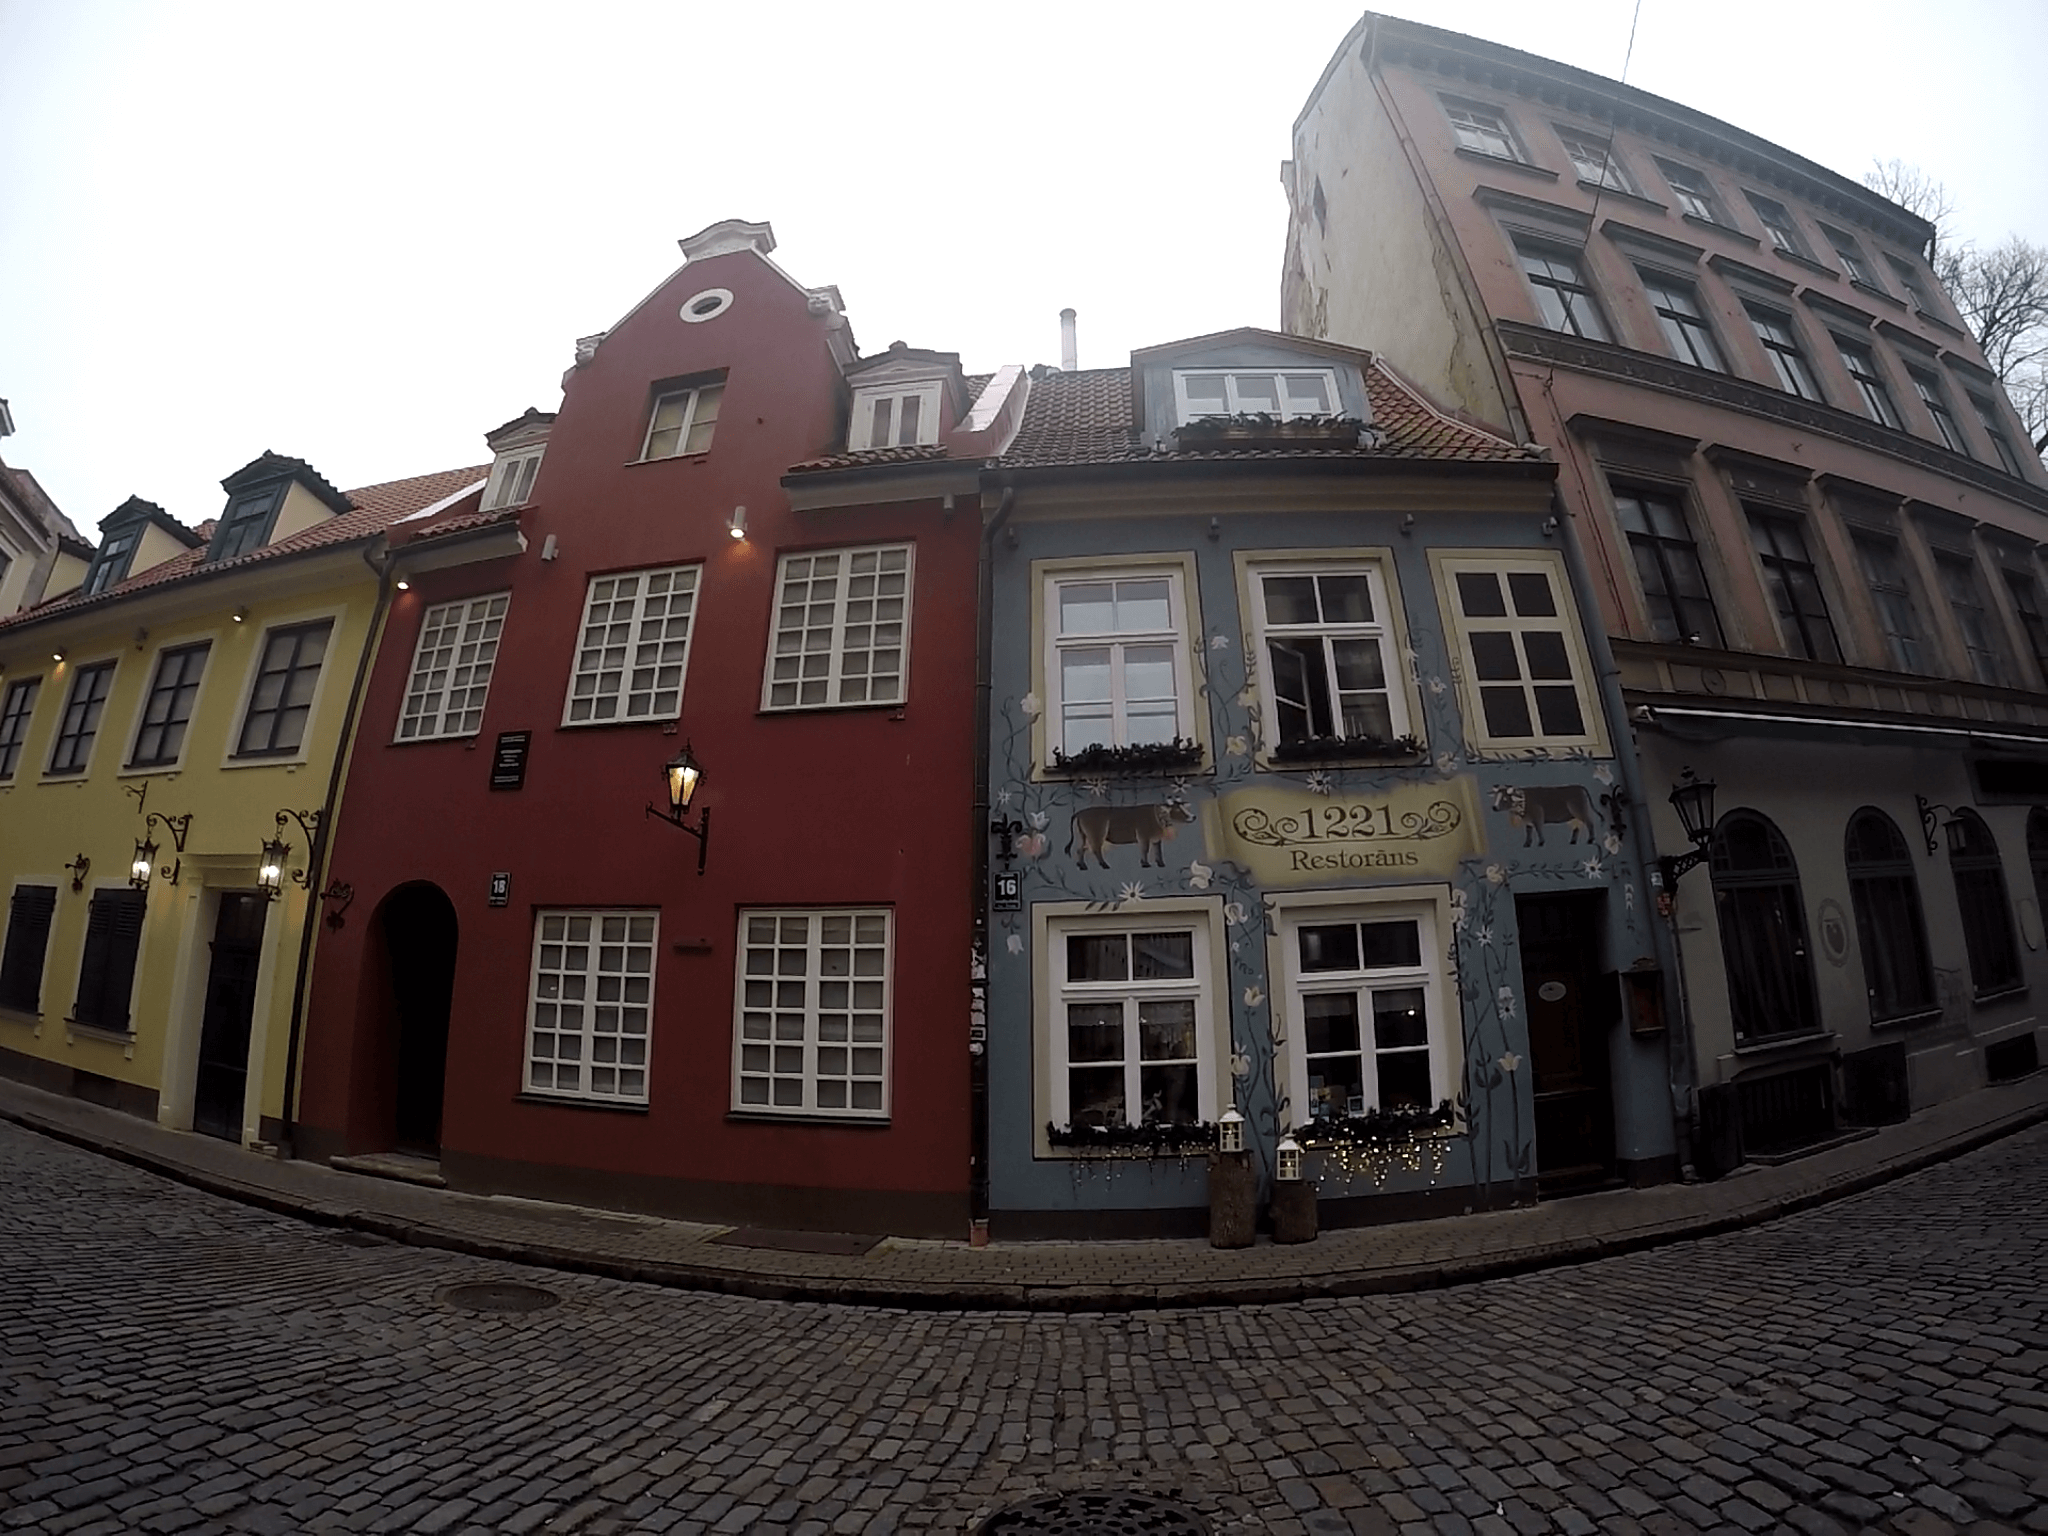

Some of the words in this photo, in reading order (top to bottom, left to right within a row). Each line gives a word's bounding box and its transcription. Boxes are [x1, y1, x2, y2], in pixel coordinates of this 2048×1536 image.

[1300, 804, 1401, 839] 1221
[1290, 849, 1419, 871] Restorāns
[997, 880, 1016, 895] 16
